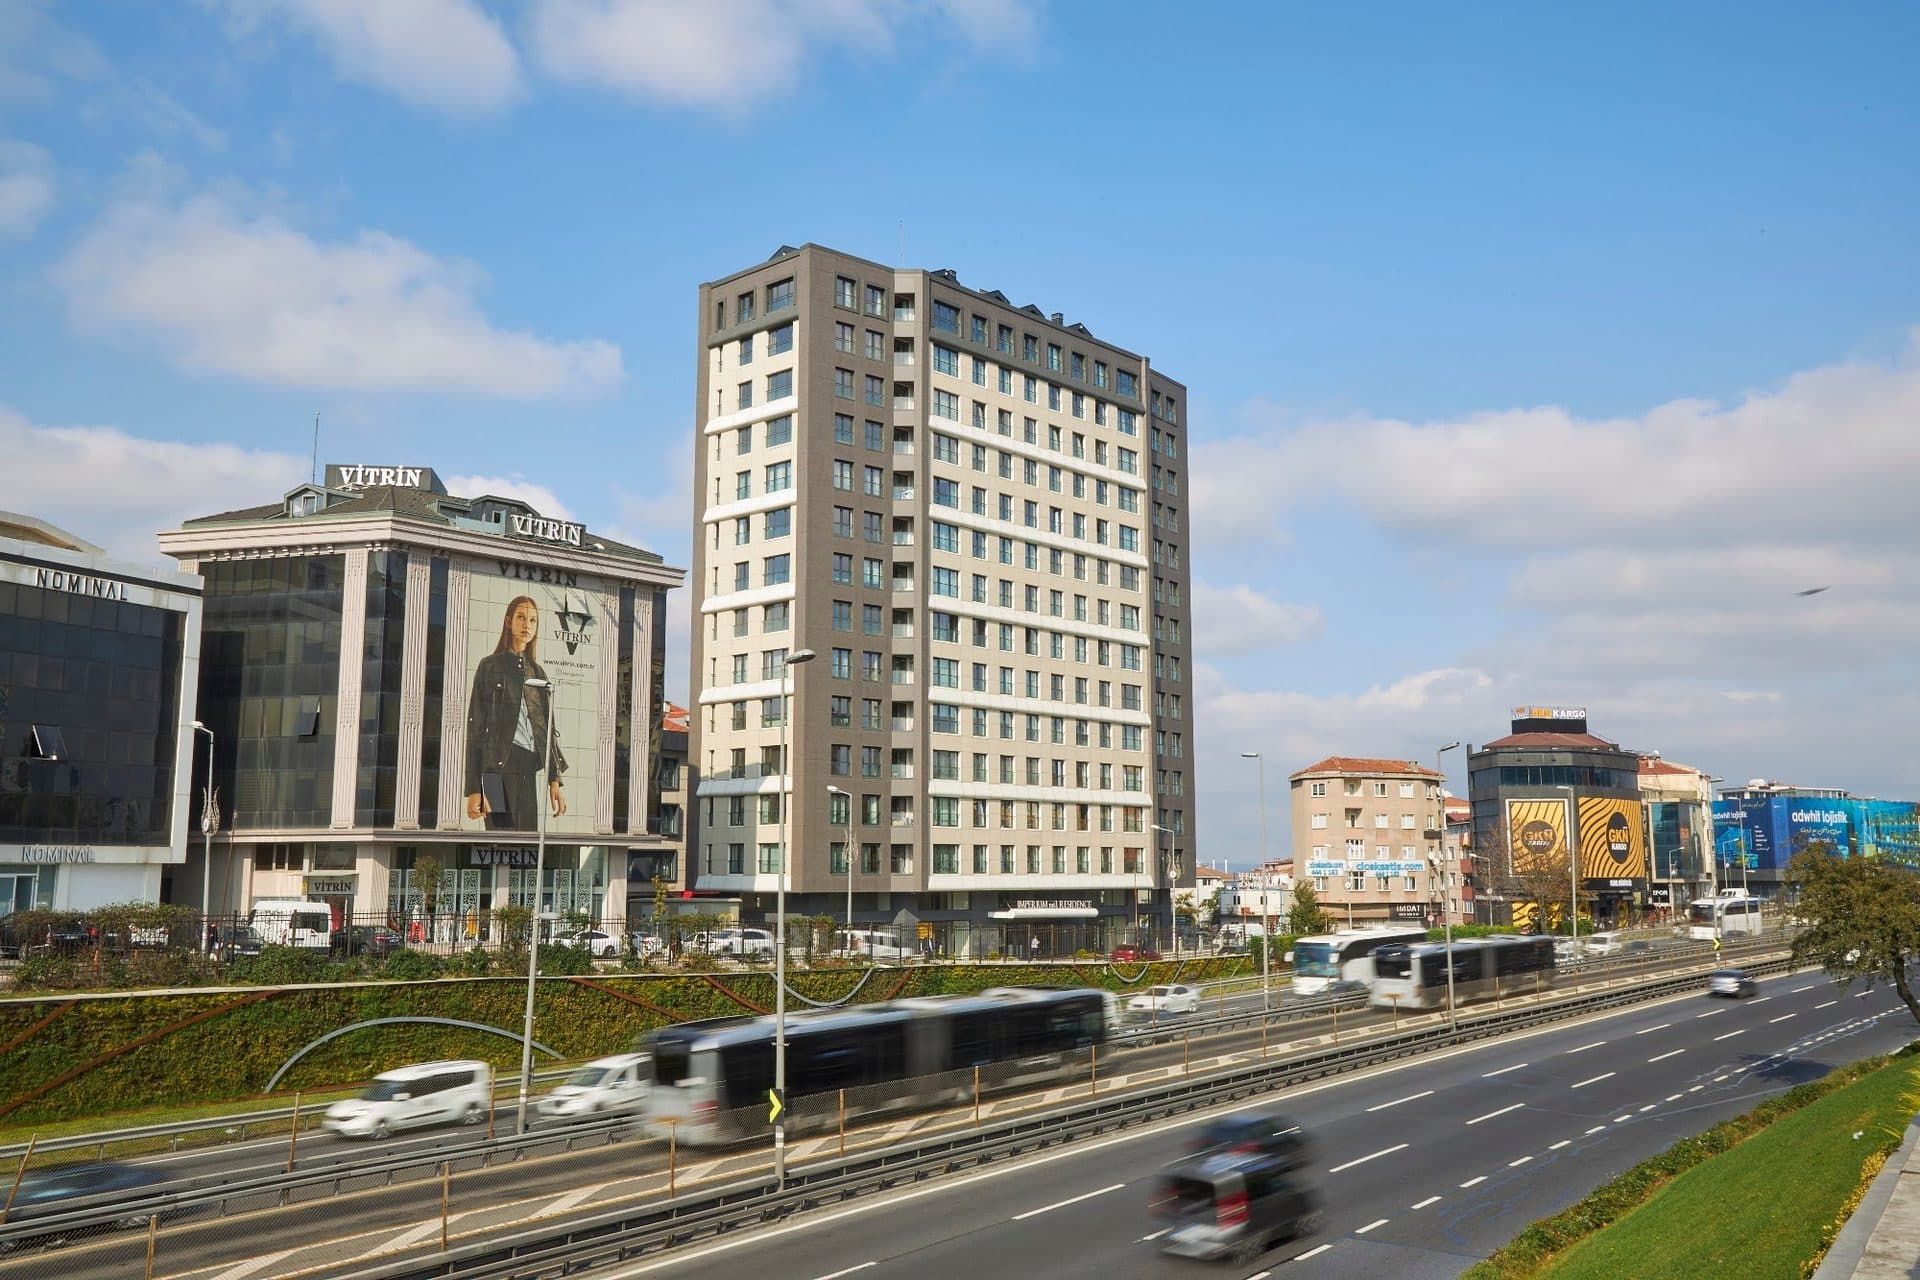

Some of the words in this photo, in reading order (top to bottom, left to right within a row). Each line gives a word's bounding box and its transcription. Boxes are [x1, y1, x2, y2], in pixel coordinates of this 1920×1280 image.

[339, 464, 422, 487] VİTRİN
[510, 513, 582, 546] VİTRİN
[36, 568, 128, 601] NOMINAL
[1553, 709, 1586, 718] KARGO
[1608, 828, 1629, 843] GKN
[22, 845, 96, 864] NOMINAL
